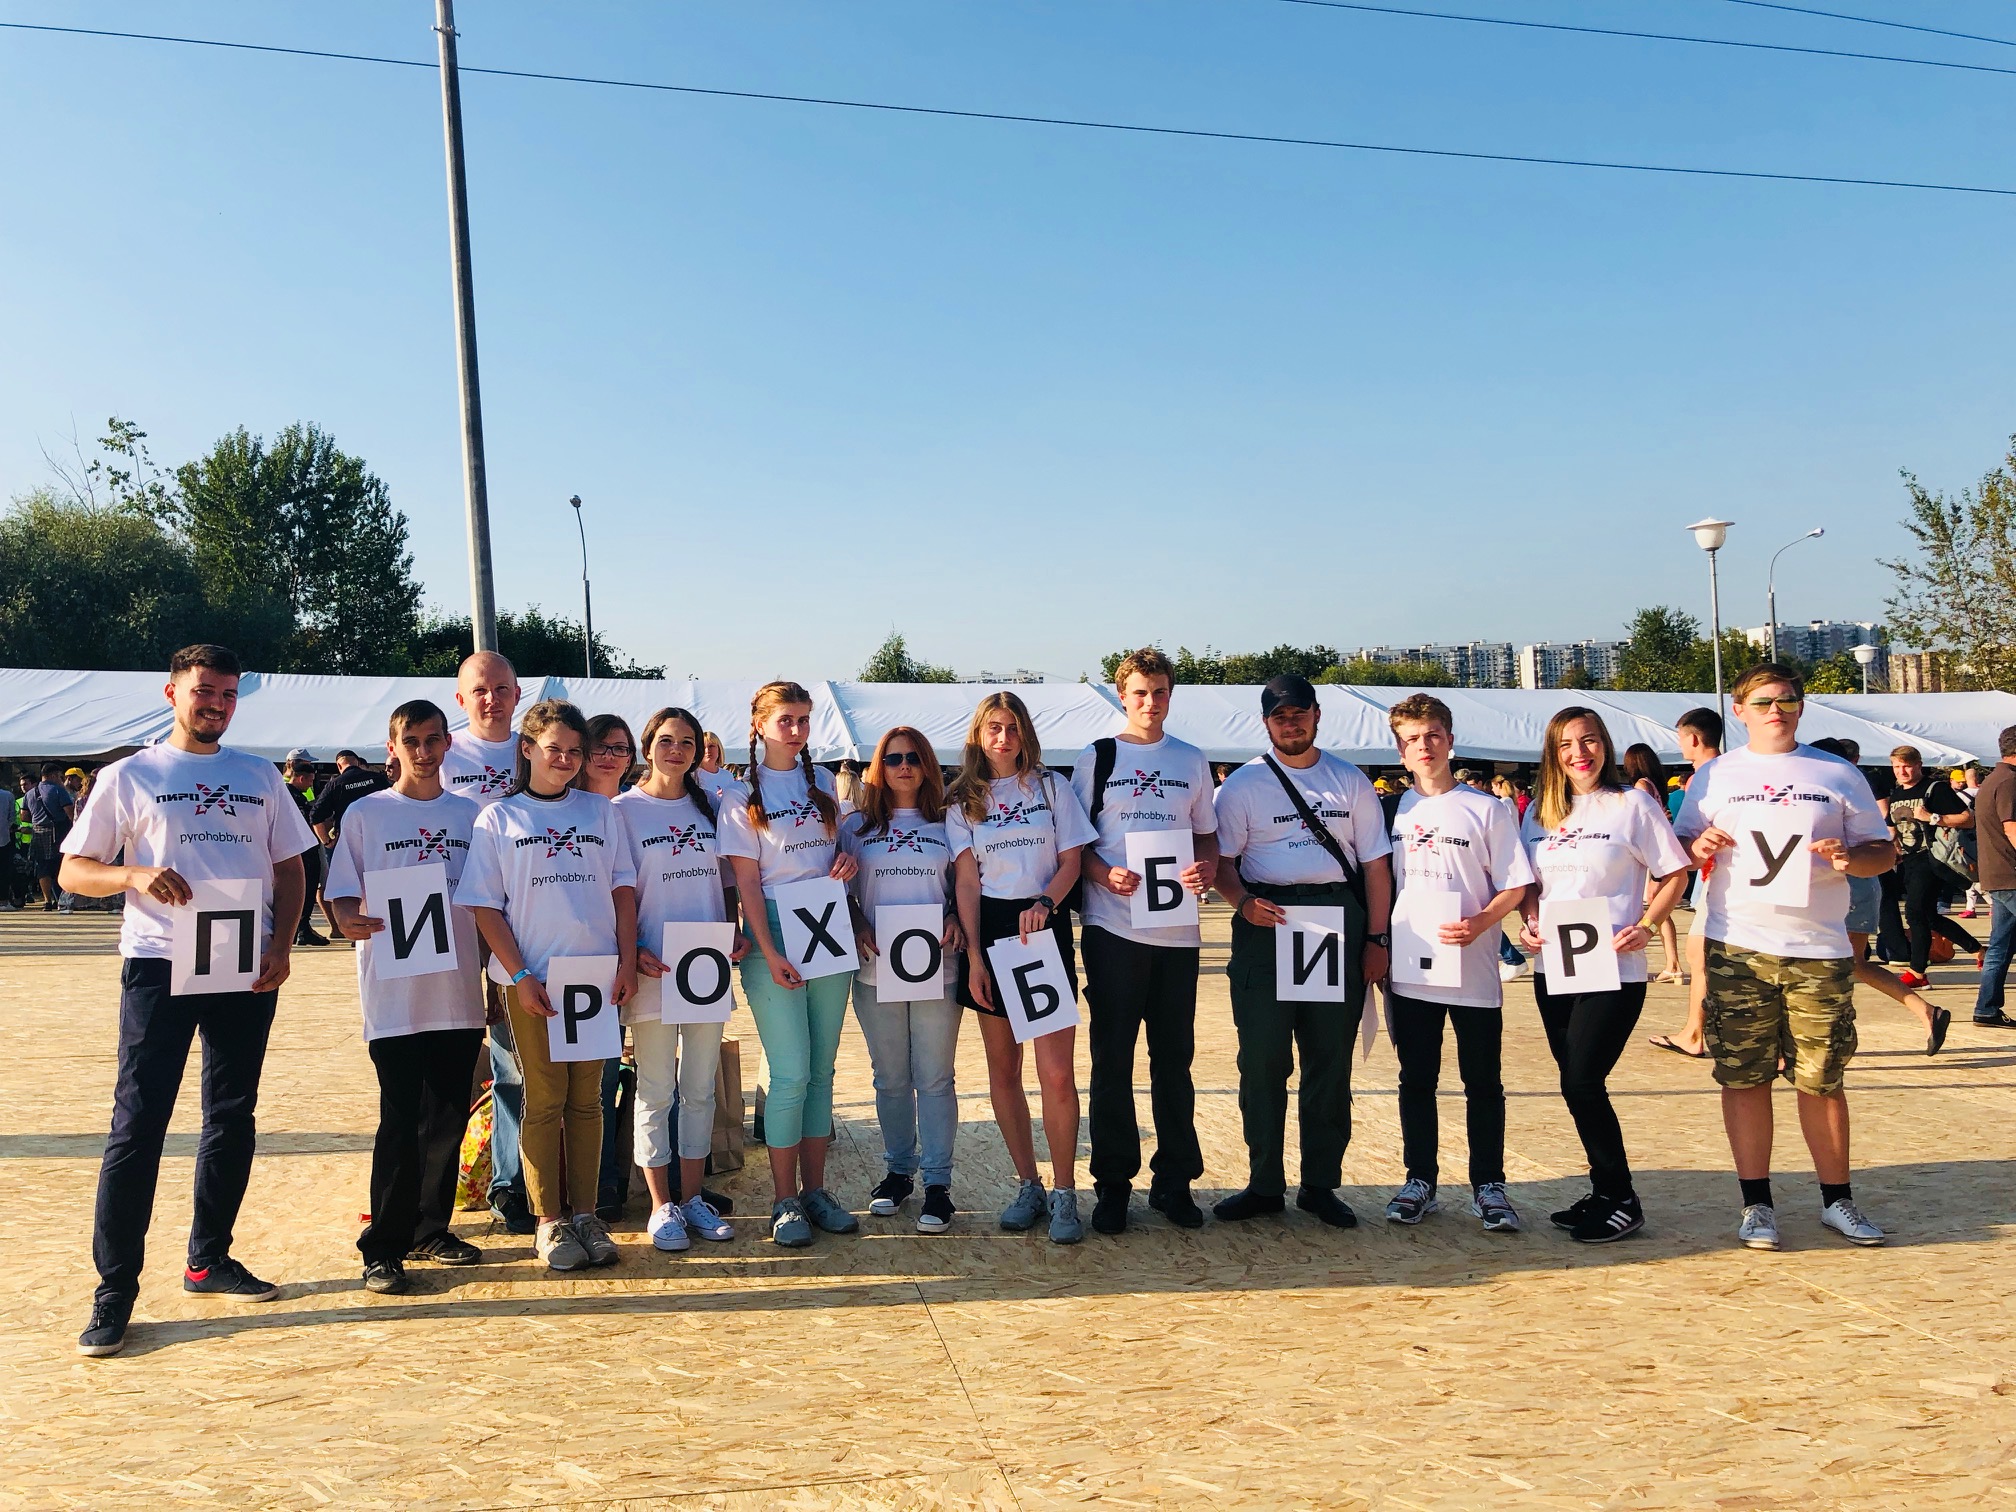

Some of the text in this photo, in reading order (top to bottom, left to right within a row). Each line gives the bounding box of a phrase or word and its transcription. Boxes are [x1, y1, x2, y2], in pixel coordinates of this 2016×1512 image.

[345, 779, 374, 790] ПОЛИЦИЯ
[180, 831, 252, 845] pyrohobby.ru
[1121, 811, 1177, 823] pyrohobby.ru
[874, 866, 936, 878] pyrohobby.ru
[985, 837, 1046, 853] pyrohobby.ru
[1750, 830, 1803, 887] У
[662, 867, 717, 882] pyrohobby.ru
[1145, 857, 1183, 911] Б
[195, 910, 254, 975] П
[388, 893, 449, 959] И
[792, 902, 847, 964] Х
[1558, 923, 1598, 976] Р
[676, 947, 730, 1005] О
[890, 929, 942, 983] О
[1293, 931, 1338, 986] И
[563, 985, 602, 1044] Р
[1012, 960, 1059, 1022] Б
